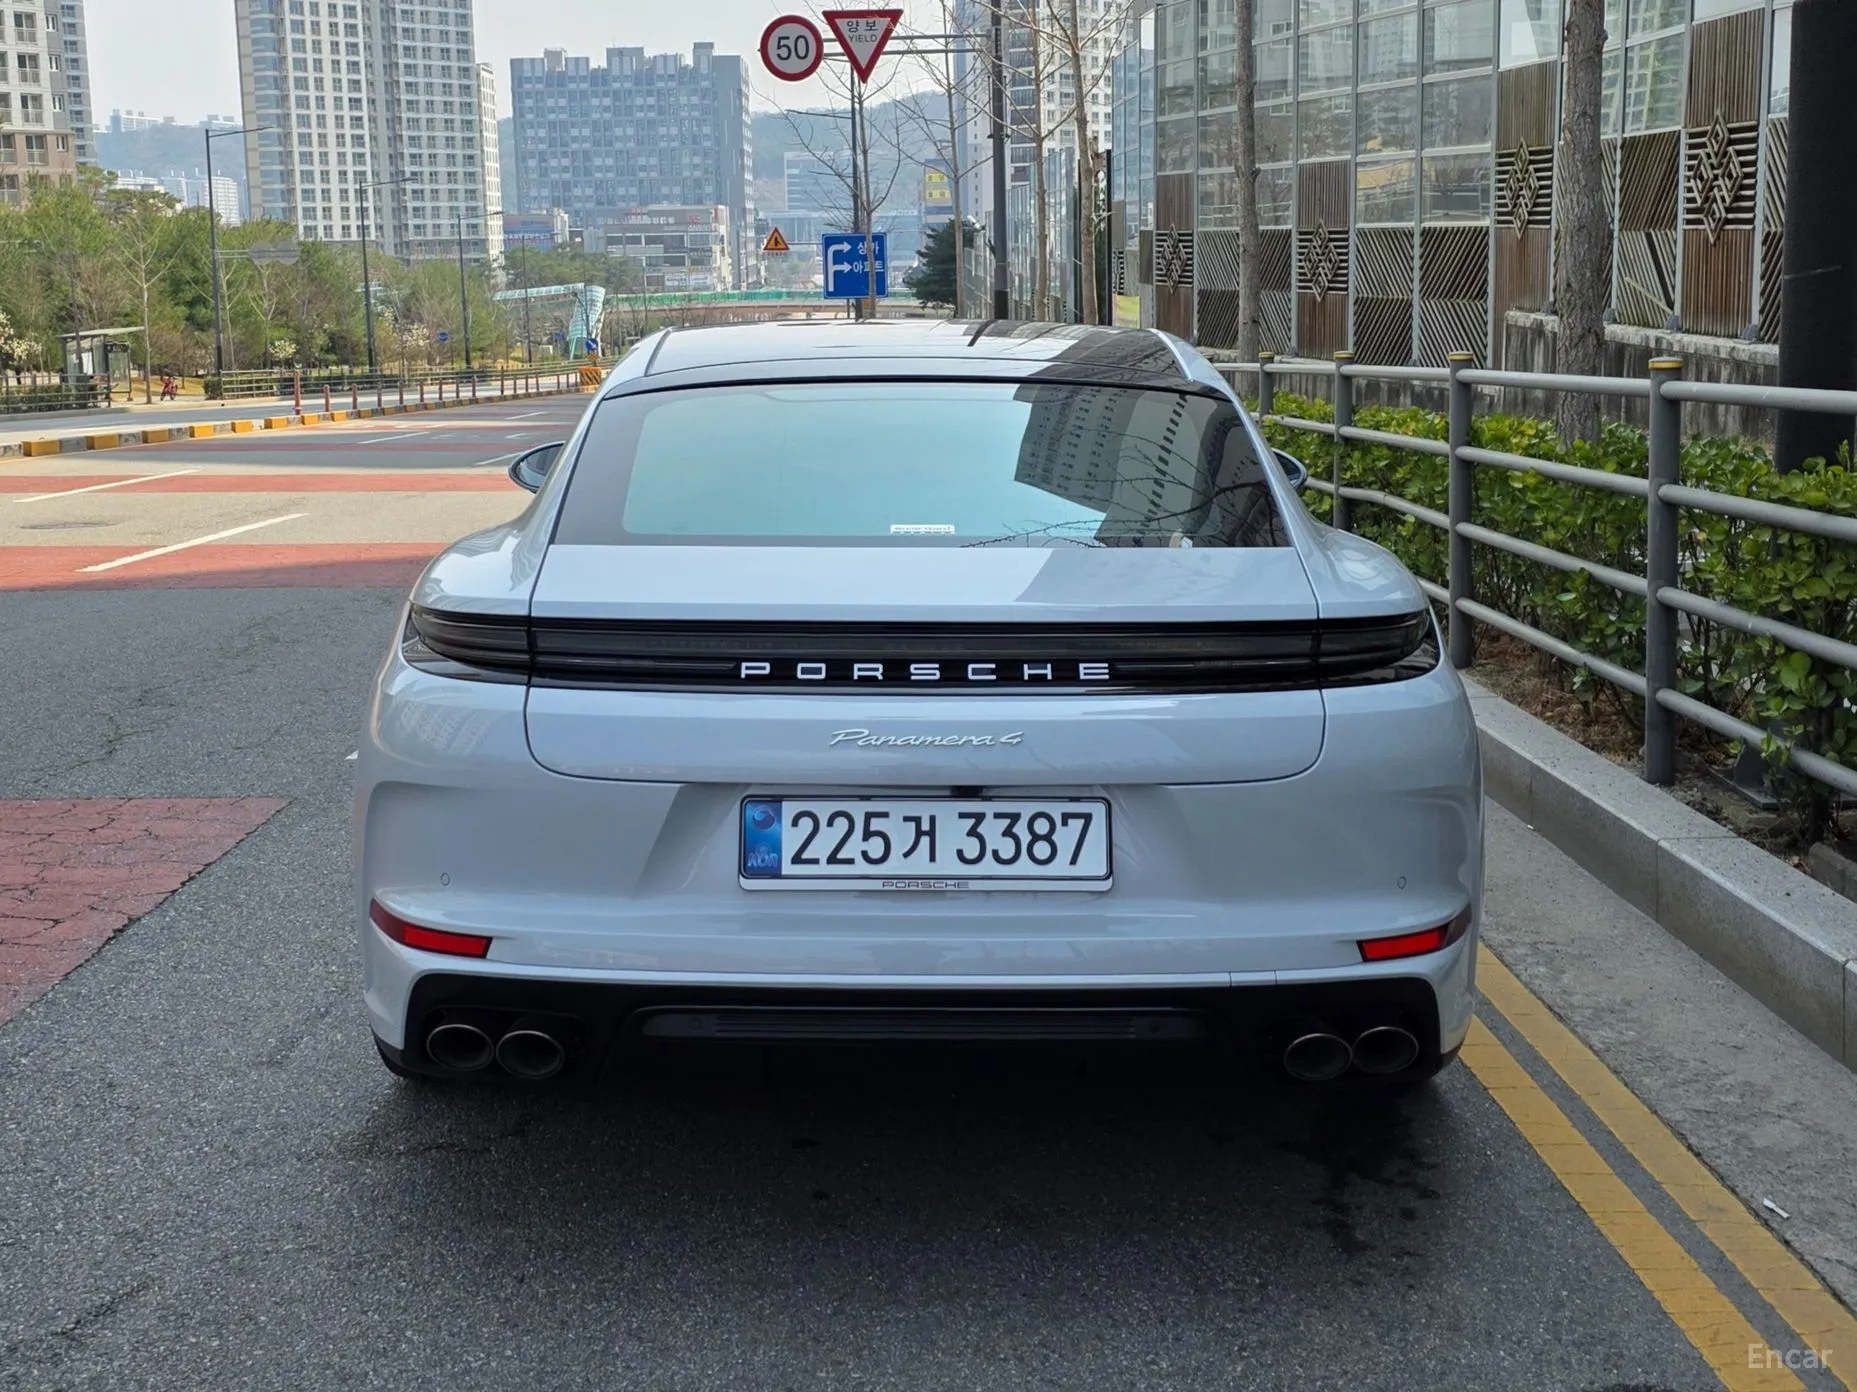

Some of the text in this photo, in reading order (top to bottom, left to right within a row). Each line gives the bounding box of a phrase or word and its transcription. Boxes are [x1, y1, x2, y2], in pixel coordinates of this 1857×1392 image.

[848, 34, 877, 43] YIELD
[776, 35, 810, 61] 50
[740, 662, 1110, 680] PORSCHE
[829, 728, 1024, 747] Panamera 4
[790, 810, 1093, 866] 225거 3387
[882, 881, 969, 889] PORSCHE
